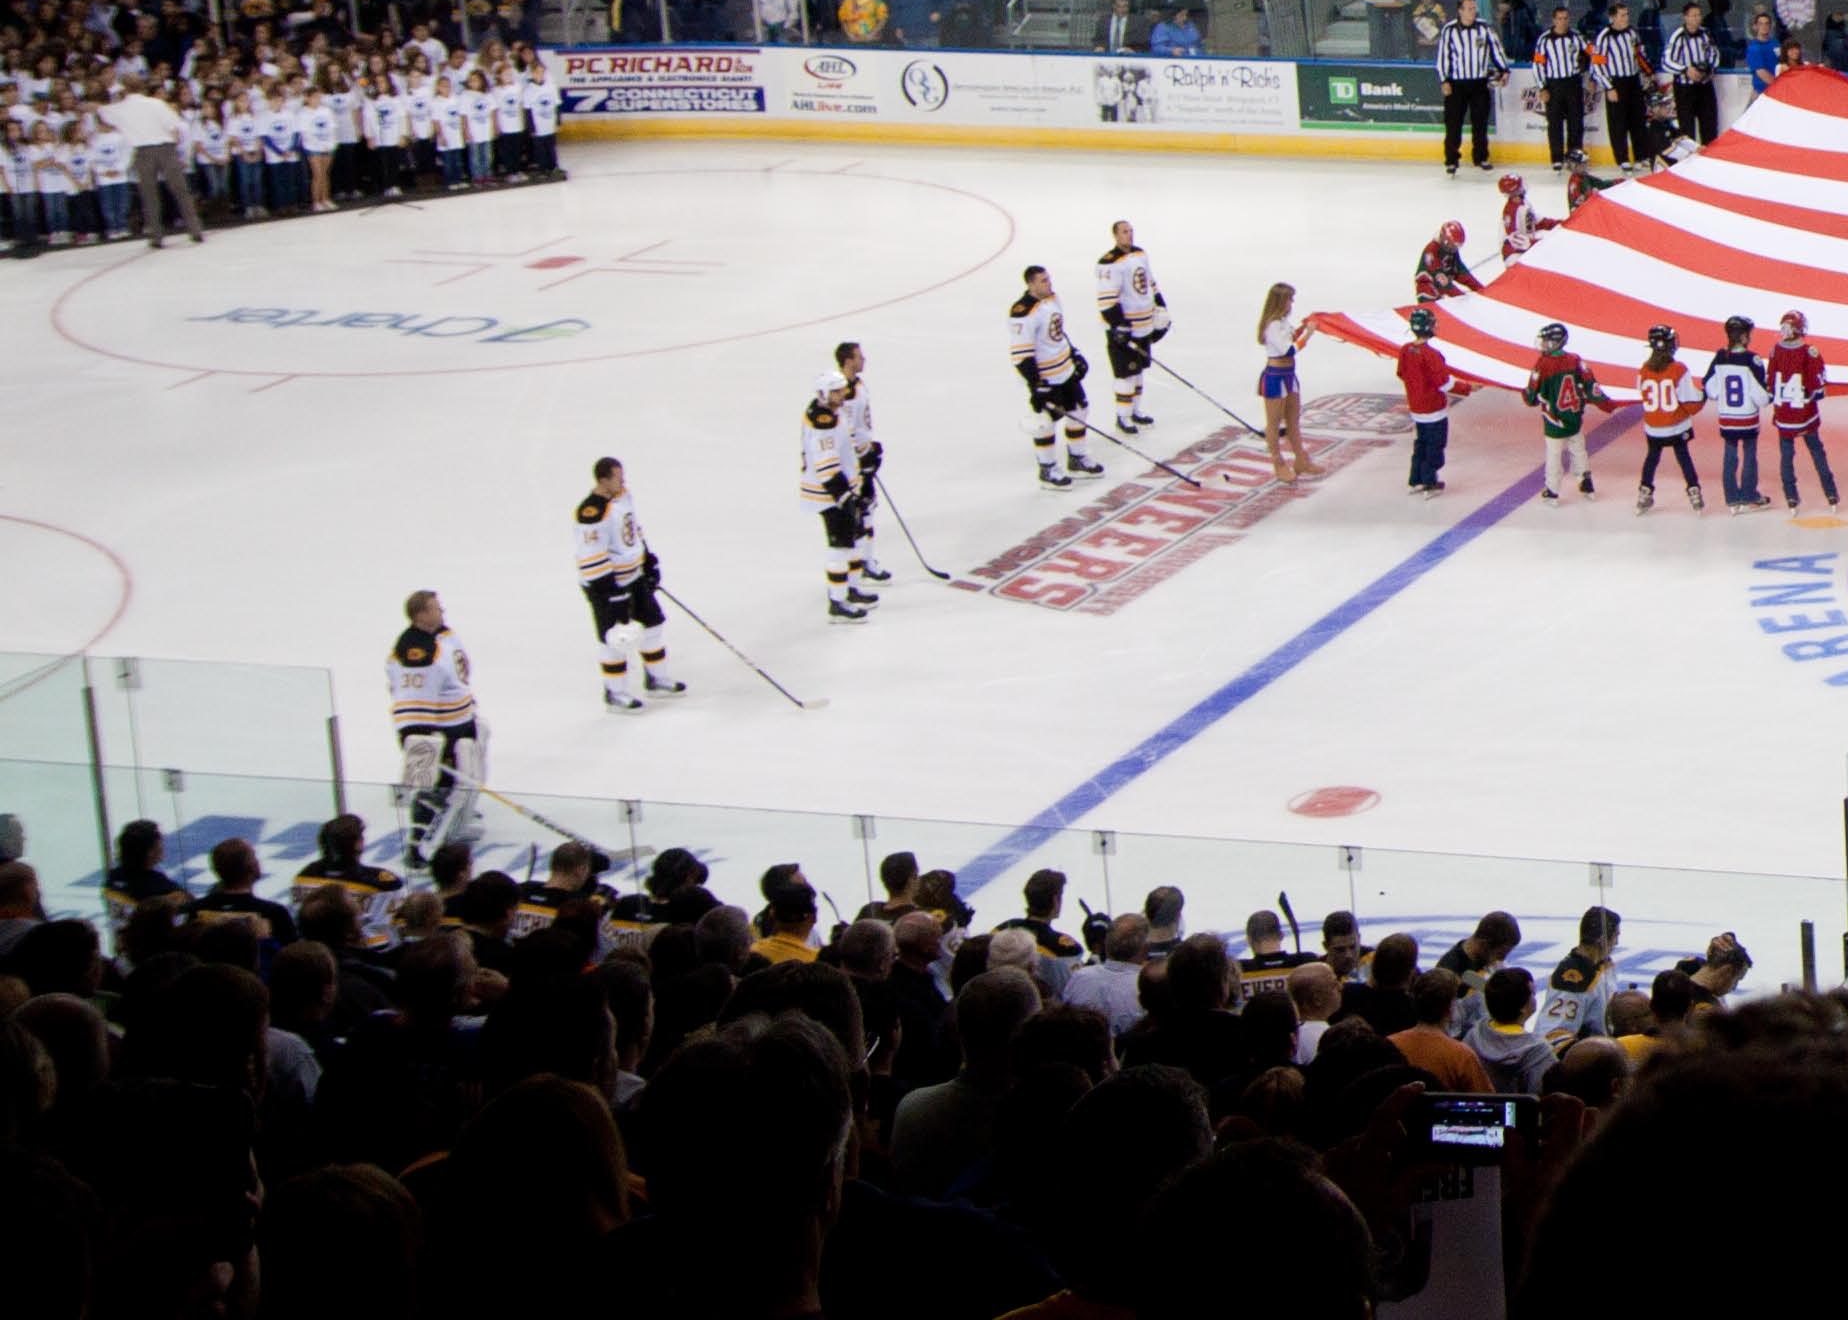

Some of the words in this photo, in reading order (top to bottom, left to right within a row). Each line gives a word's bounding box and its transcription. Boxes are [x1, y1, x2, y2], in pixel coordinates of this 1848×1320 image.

[567, 58, 602, 74] PC
[610, 56, 732, 73] RICHARD
[1164, 64, 1213, 93] Ralph
[1332, 82, 1355, 99] TD
[1360, 82, 1403, 97] Bank
[574, 91, 608, 111] 7
[611, 89, 756, 100] CONNECTICUT
[606, 100, 757, 112] SUPERSTORES
[186, 306, 498, 339] Charter
[1558, 376, 1581, 413] 4
[1641, 379, 1679, 412] 30
[1725, 375, 1745, 408] 8
[1774, 372, 1804, 408] 14
[1242, 978, 1286, 1001] EYER
[1548, 997, 1579, 1019] 23
